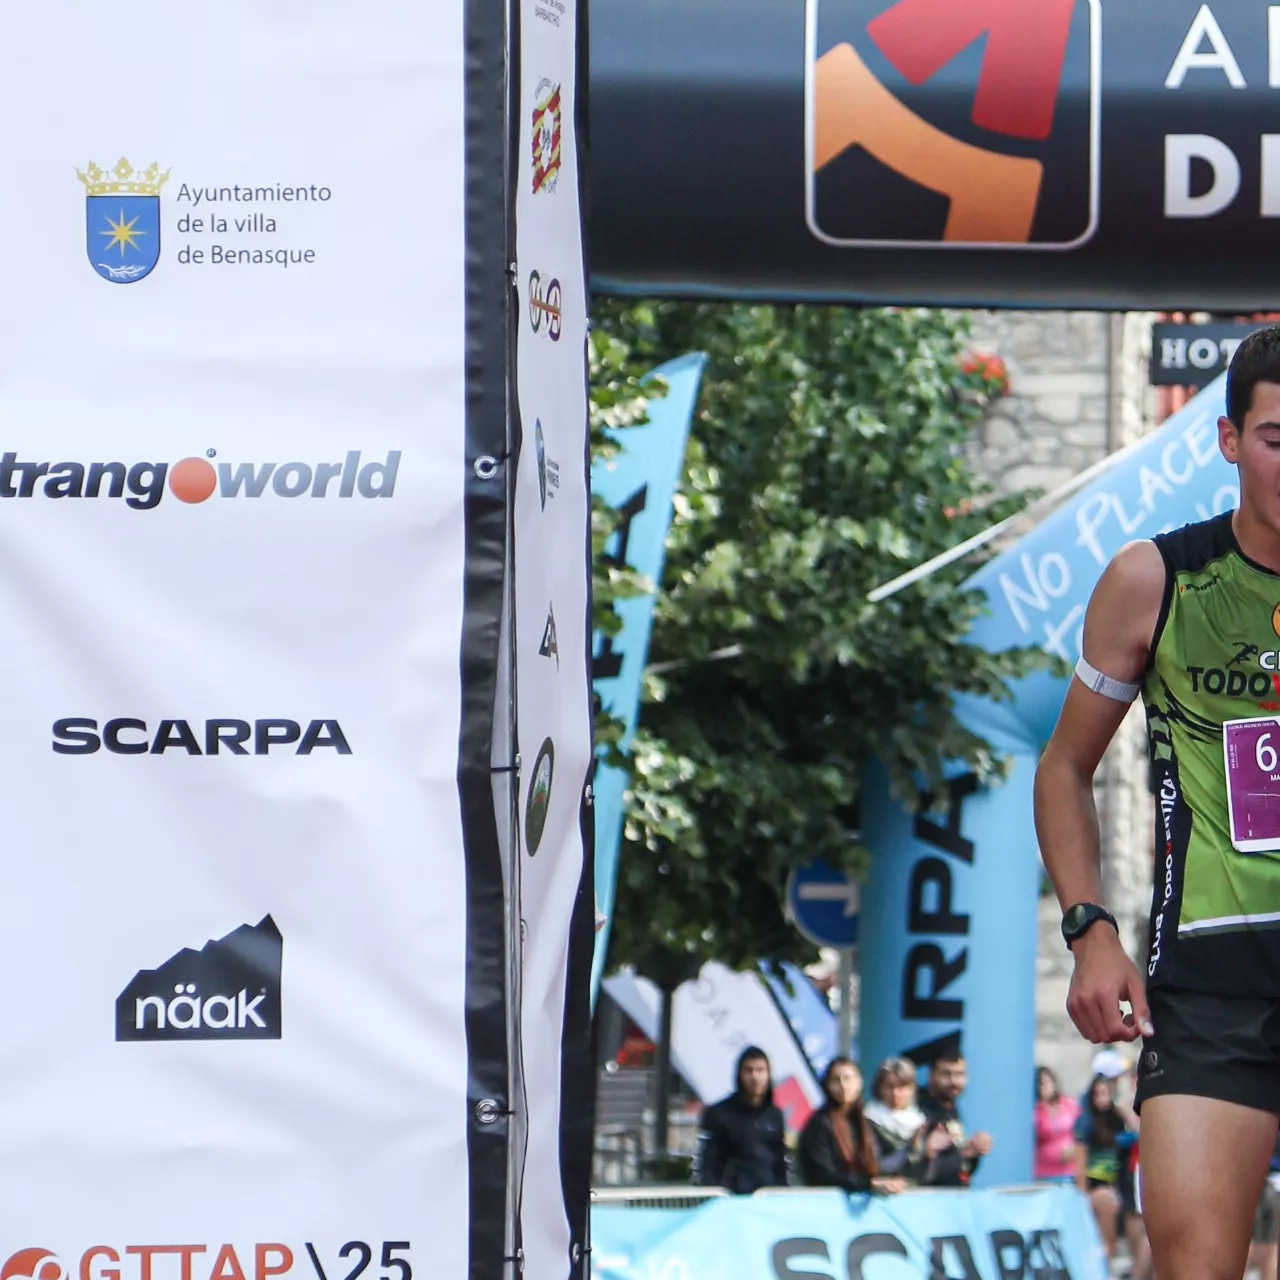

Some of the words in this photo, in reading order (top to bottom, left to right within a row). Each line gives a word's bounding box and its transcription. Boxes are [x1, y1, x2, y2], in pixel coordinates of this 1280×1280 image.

[177, 183, 332, 206] Ayuntamiento
[177, 214, 204, 234] de
[210, 214, 228, 234] la
[234, 214, 277, 234] villa
[177, 245, 204, 265] de
[211, 245, 316, 269] Benasque
[52, 717, 353, 756] SCARPA
[135, 983, 267, 1030] näak
